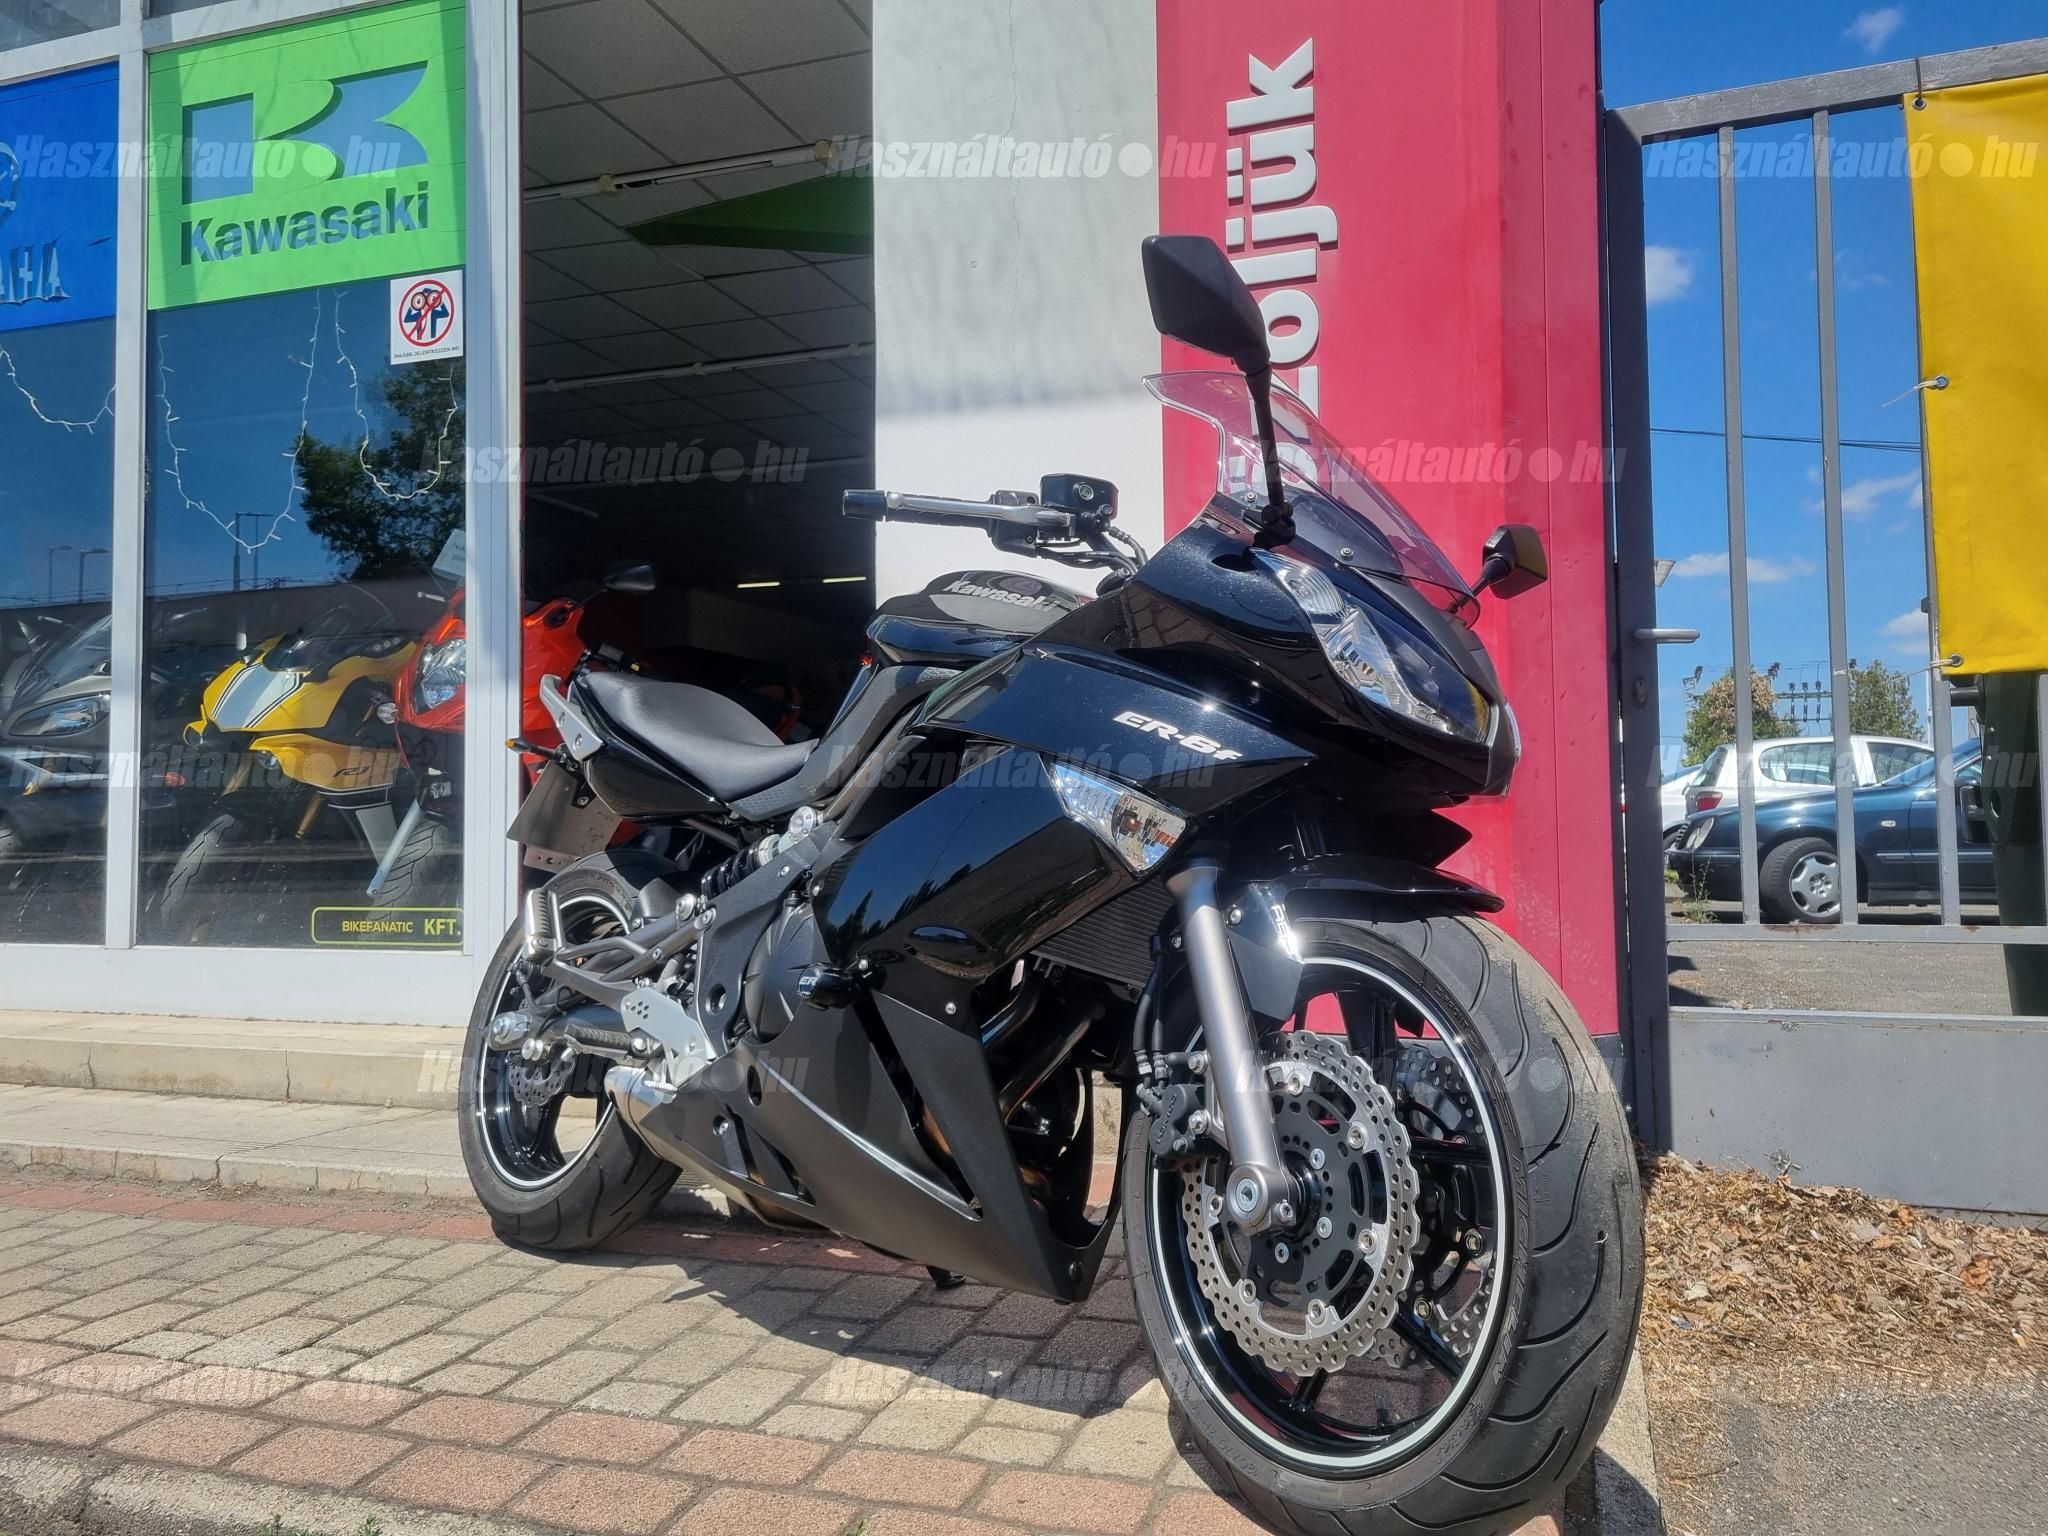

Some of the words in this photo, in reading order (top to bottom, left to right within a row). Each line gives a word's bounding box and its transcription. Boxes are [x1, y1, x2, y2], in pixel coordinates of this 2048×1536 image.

[181, 181, 429, 266] Kawasaki
[942, 580, 1060, 612] Kawasaki
[1113, 711, 1243, 760] ER-6f
[342, 920, 414, 933] BIKEFANATIC
[424, 918, 461, 936] KFT.
